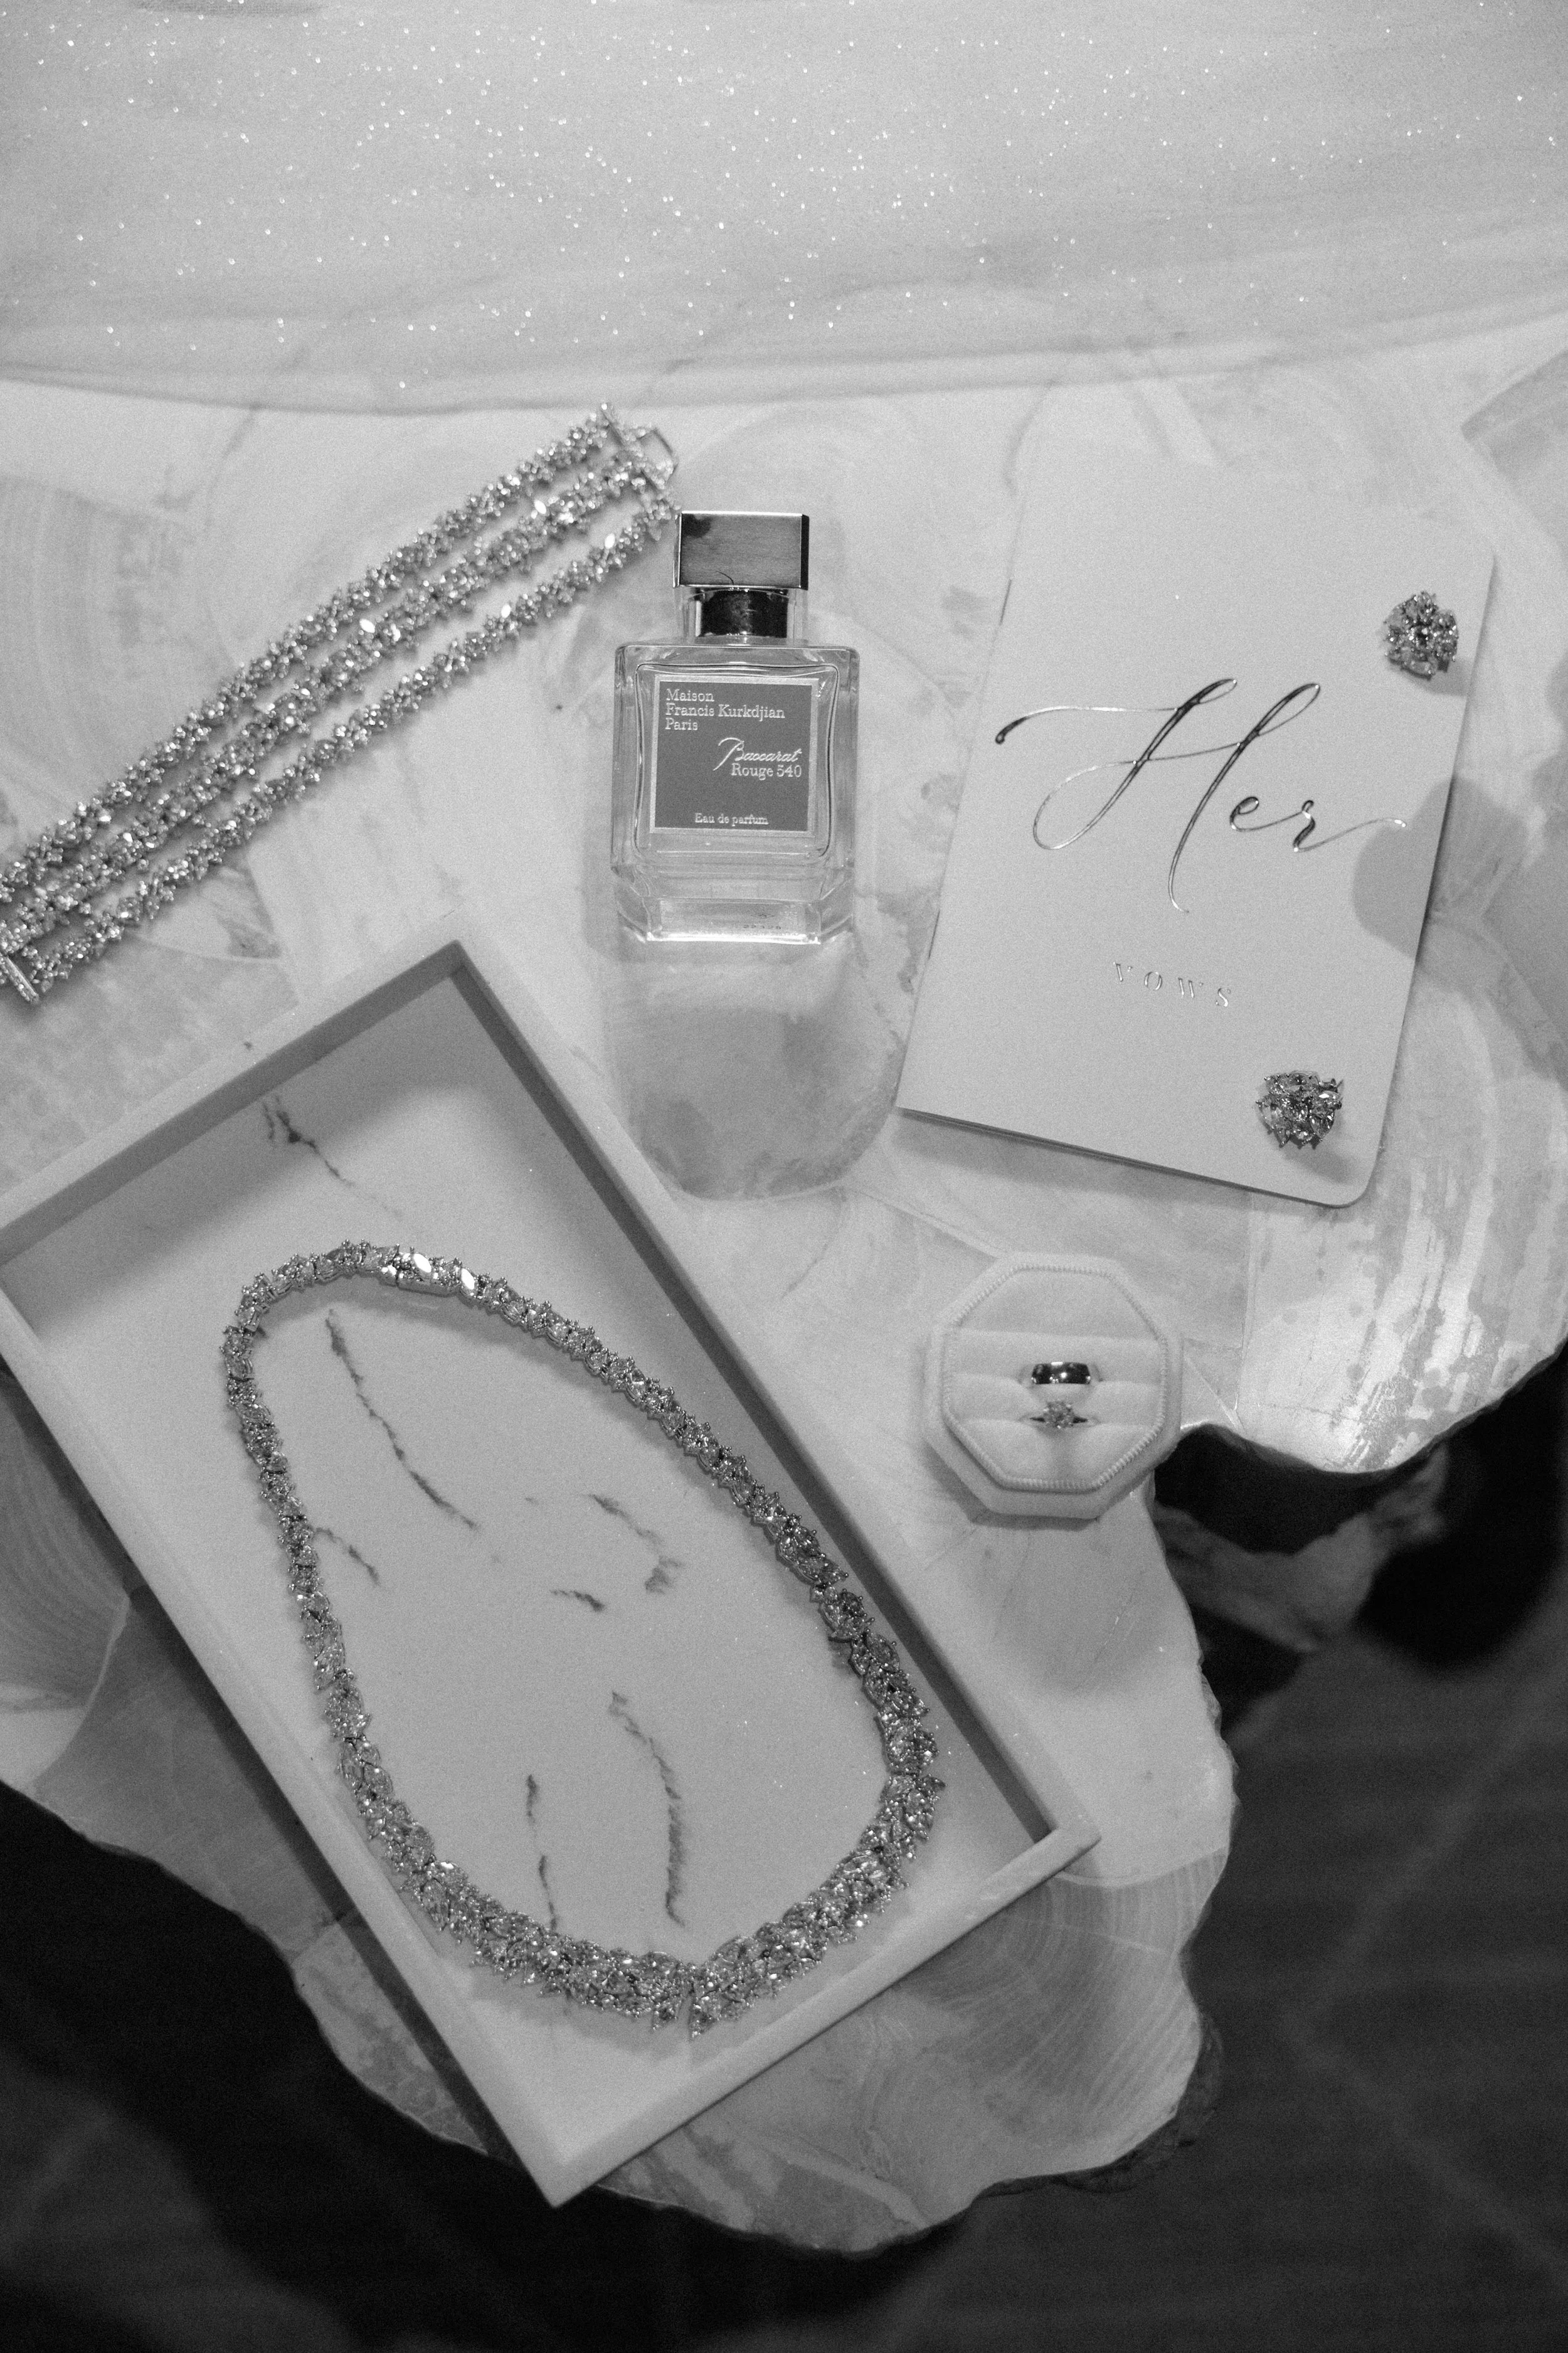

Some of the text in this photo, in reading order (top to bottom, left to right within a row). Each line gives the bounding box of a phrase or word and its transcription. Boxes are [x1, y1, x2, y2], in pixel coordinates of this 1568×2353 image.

[665, 688, 715, 702] Maison
[665, 702, 786, 722] Francis Kurkdjian
[665, 717, 698, 730] Paris
[712, 736, 803, 772] Baccarat
[731, 762, 802, 780] Rouge 540
[995, 678, 1407, 913] Her
[694, 812, 769, 827] Eau de parfum
